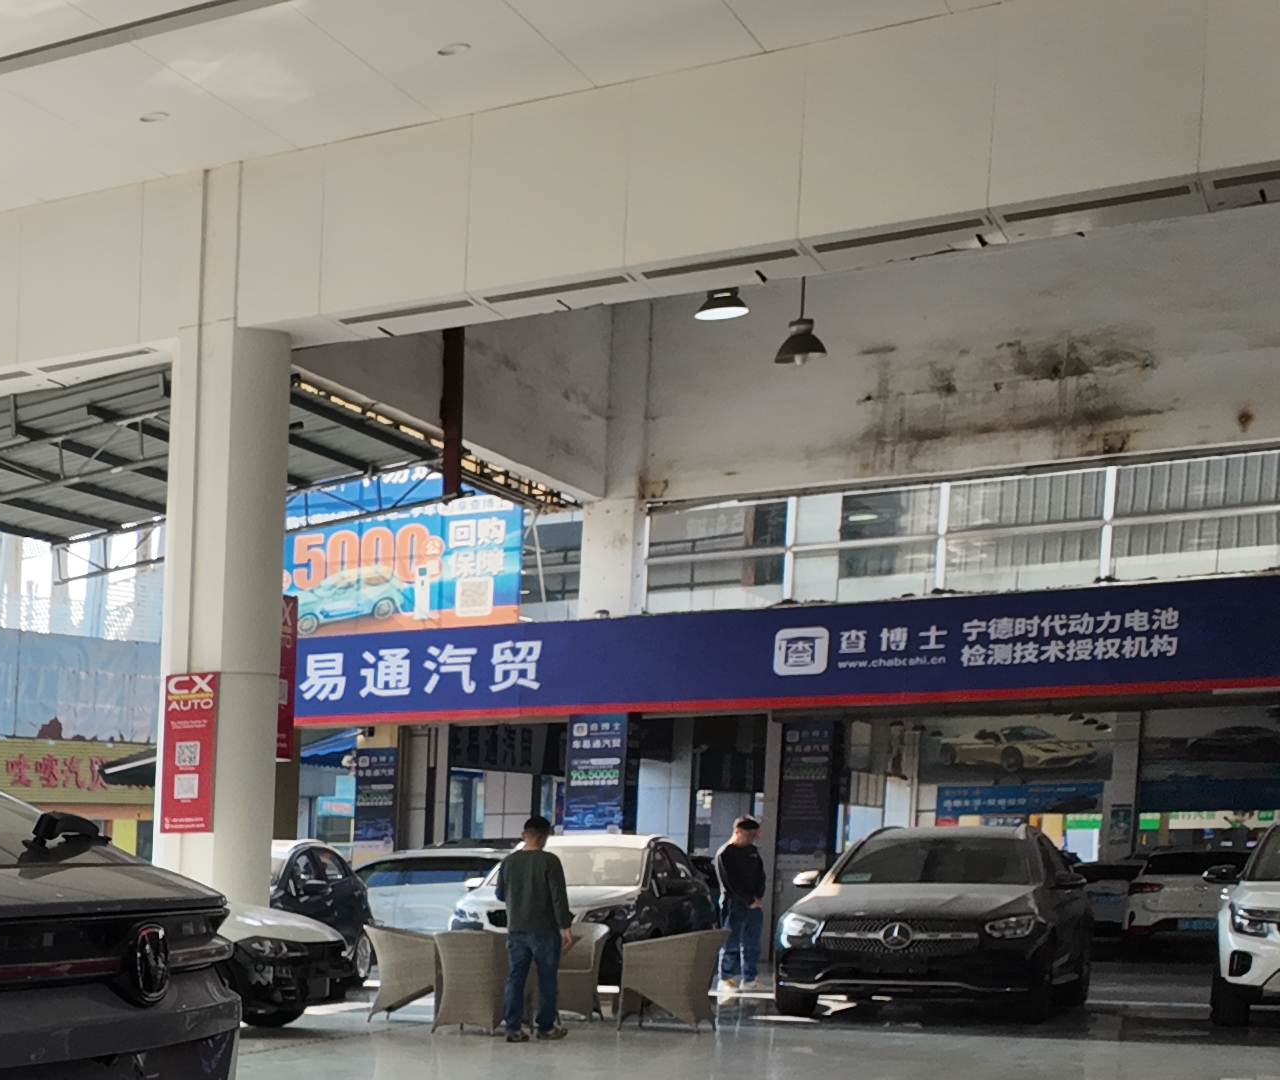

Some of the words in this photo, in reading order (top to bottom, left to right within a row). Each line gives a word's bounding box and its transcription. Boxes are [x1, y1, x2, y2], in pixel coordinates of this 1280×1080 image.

[448, 516, 507, 549] 回购
[292, 523, 439, 591] 5000
[448, 548, 506, 579] 保障
[838, 624, 949, 655] 查博士
[961, 607, 1180, 643] 宁德时代动力电池
[961, 633, 1179, 668] 检测技术授权机构
[167, 674, 214, 694] CX
[299, 640, 543, 702] 易通汽贸
[167, 698, 214, 712] AUTO
